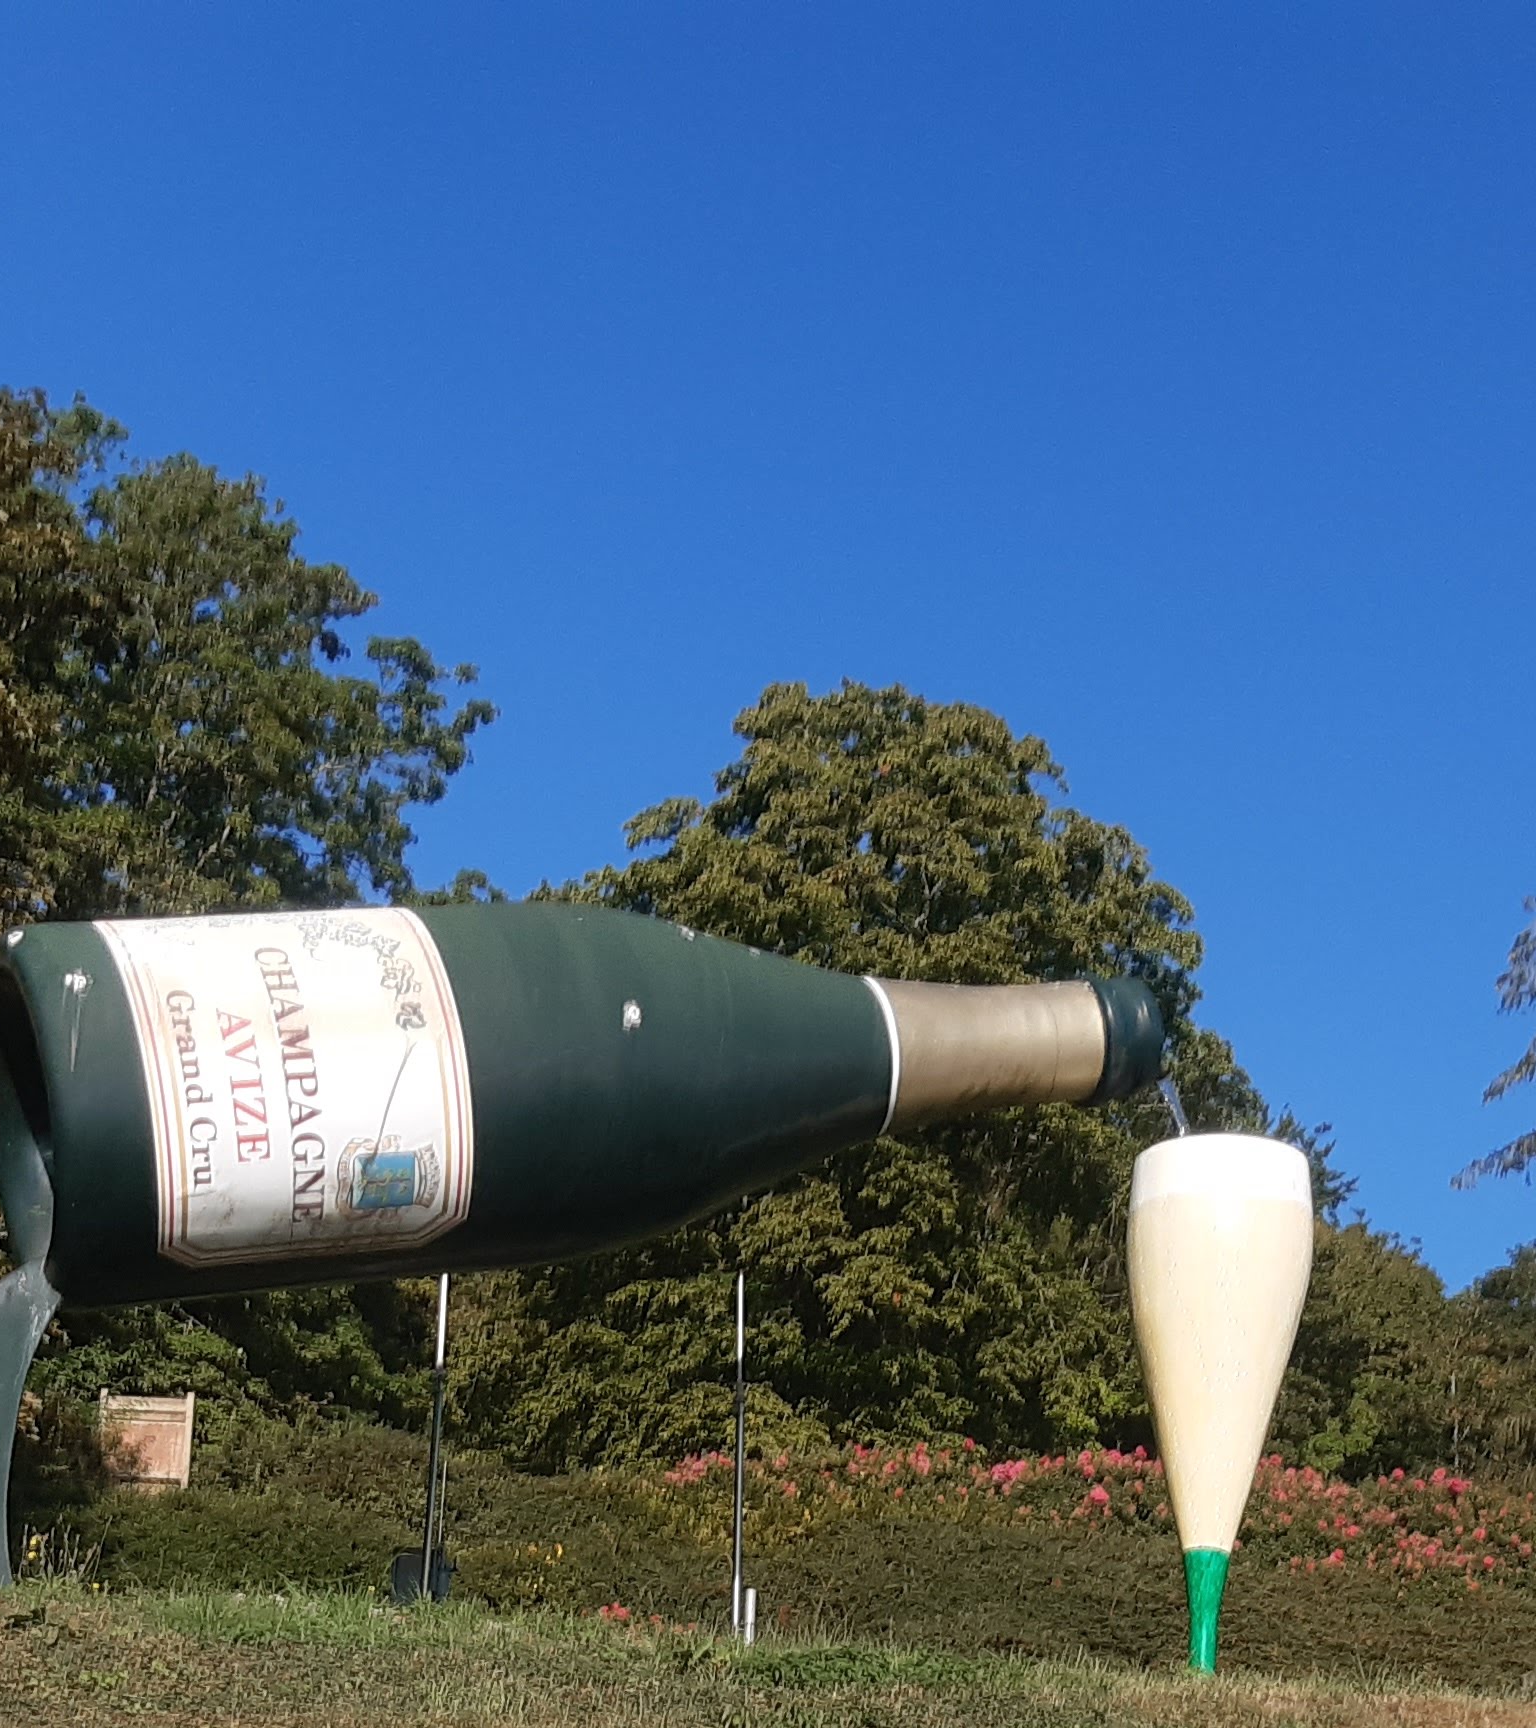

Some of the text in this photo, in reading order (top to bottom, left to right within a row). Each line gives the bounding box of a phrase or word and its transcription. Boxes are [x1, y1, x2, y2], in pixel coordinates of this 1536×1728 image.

[166, 989, 218, 1192] Grand Cru
[215, 1007, 271, 1163] AVIZE
[254, 946, 326, 1224] CHAMPAGNE
